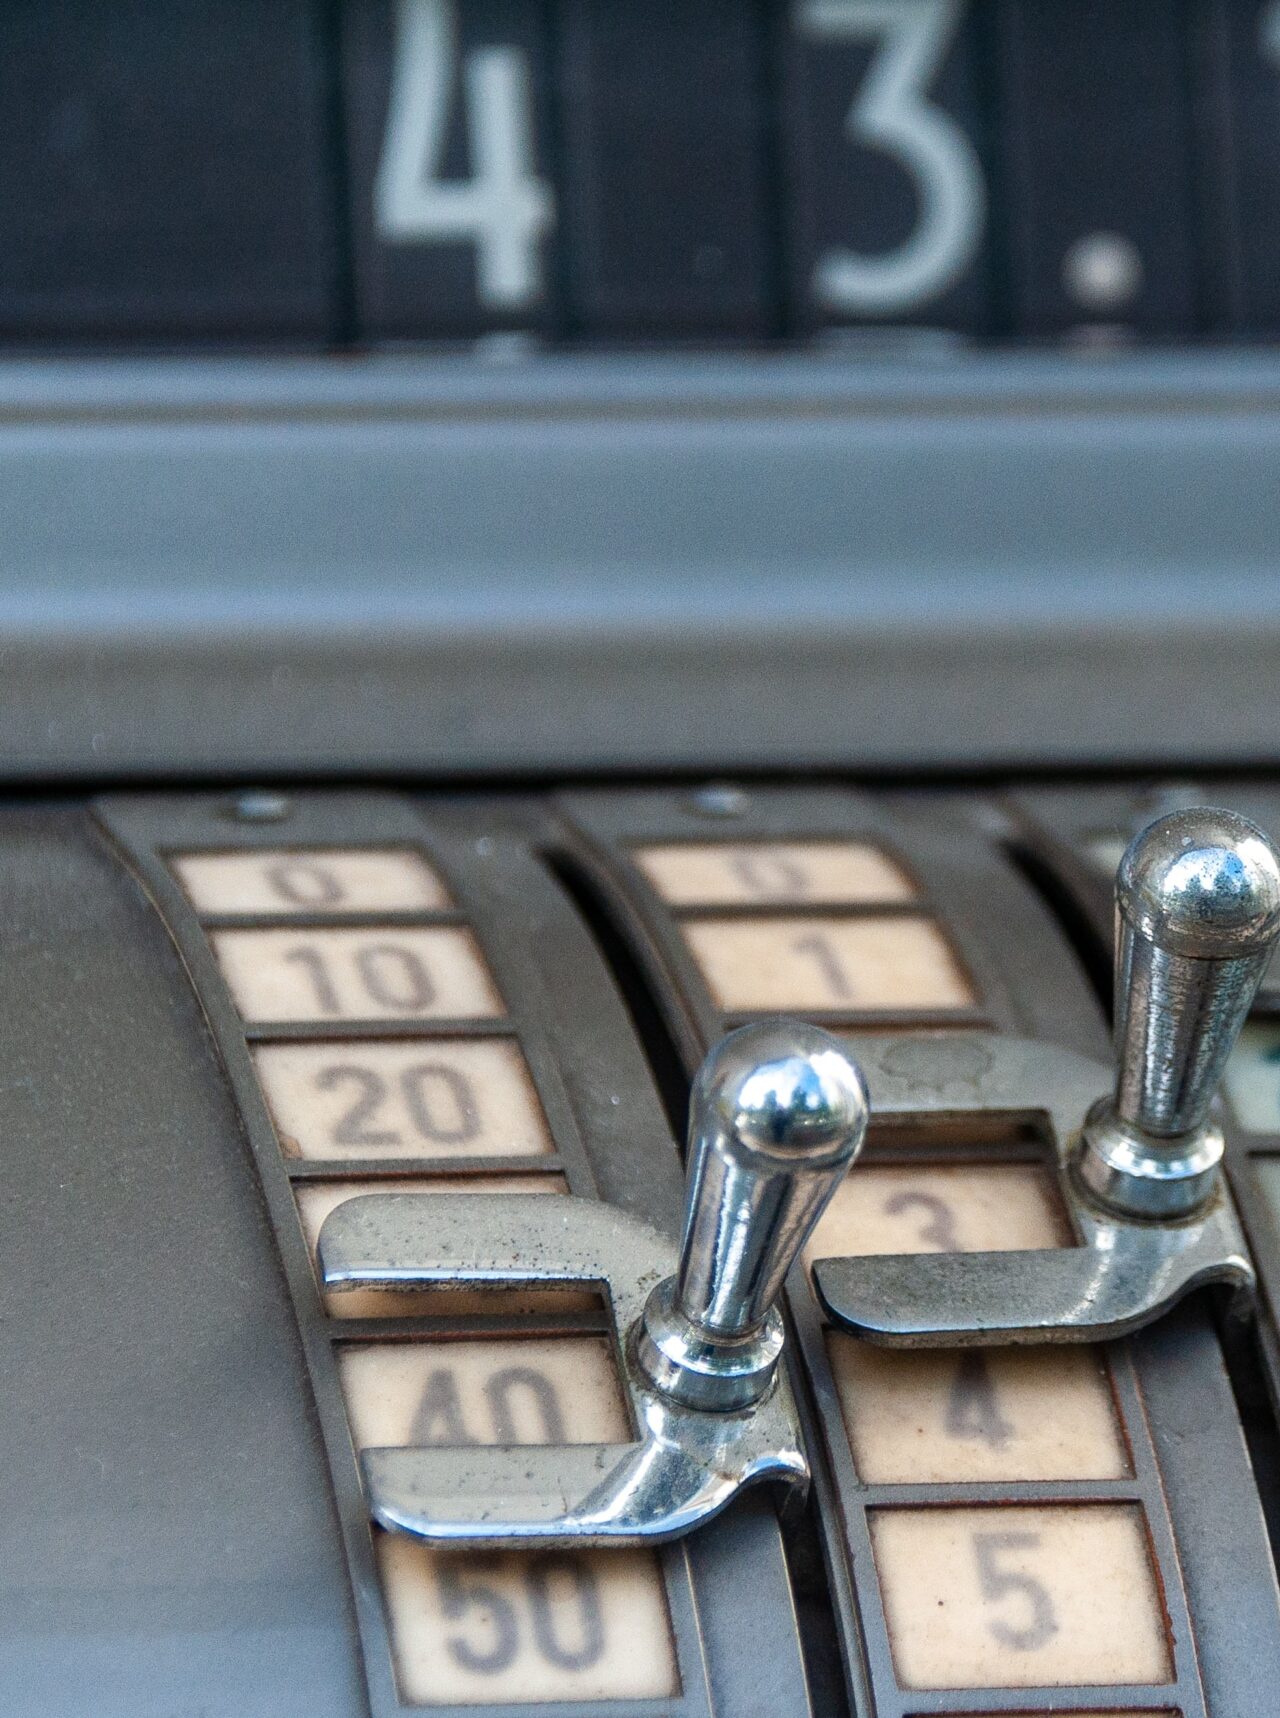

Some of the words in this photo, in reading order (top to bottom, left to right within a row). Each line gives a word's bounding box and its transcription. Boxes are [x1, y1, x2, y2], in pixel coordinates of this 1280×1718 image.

[264, 860, 346, 904] 0
[284, 944, 438, 1013] 10
[794, 934, 852, 1002] 1
[314, 1064, 482, 1148] 20
[943, 1346, 1014, 1450] 4
[433, 1555, 604, 1676] 50
[972, 1532, 1059, 1652] 5
